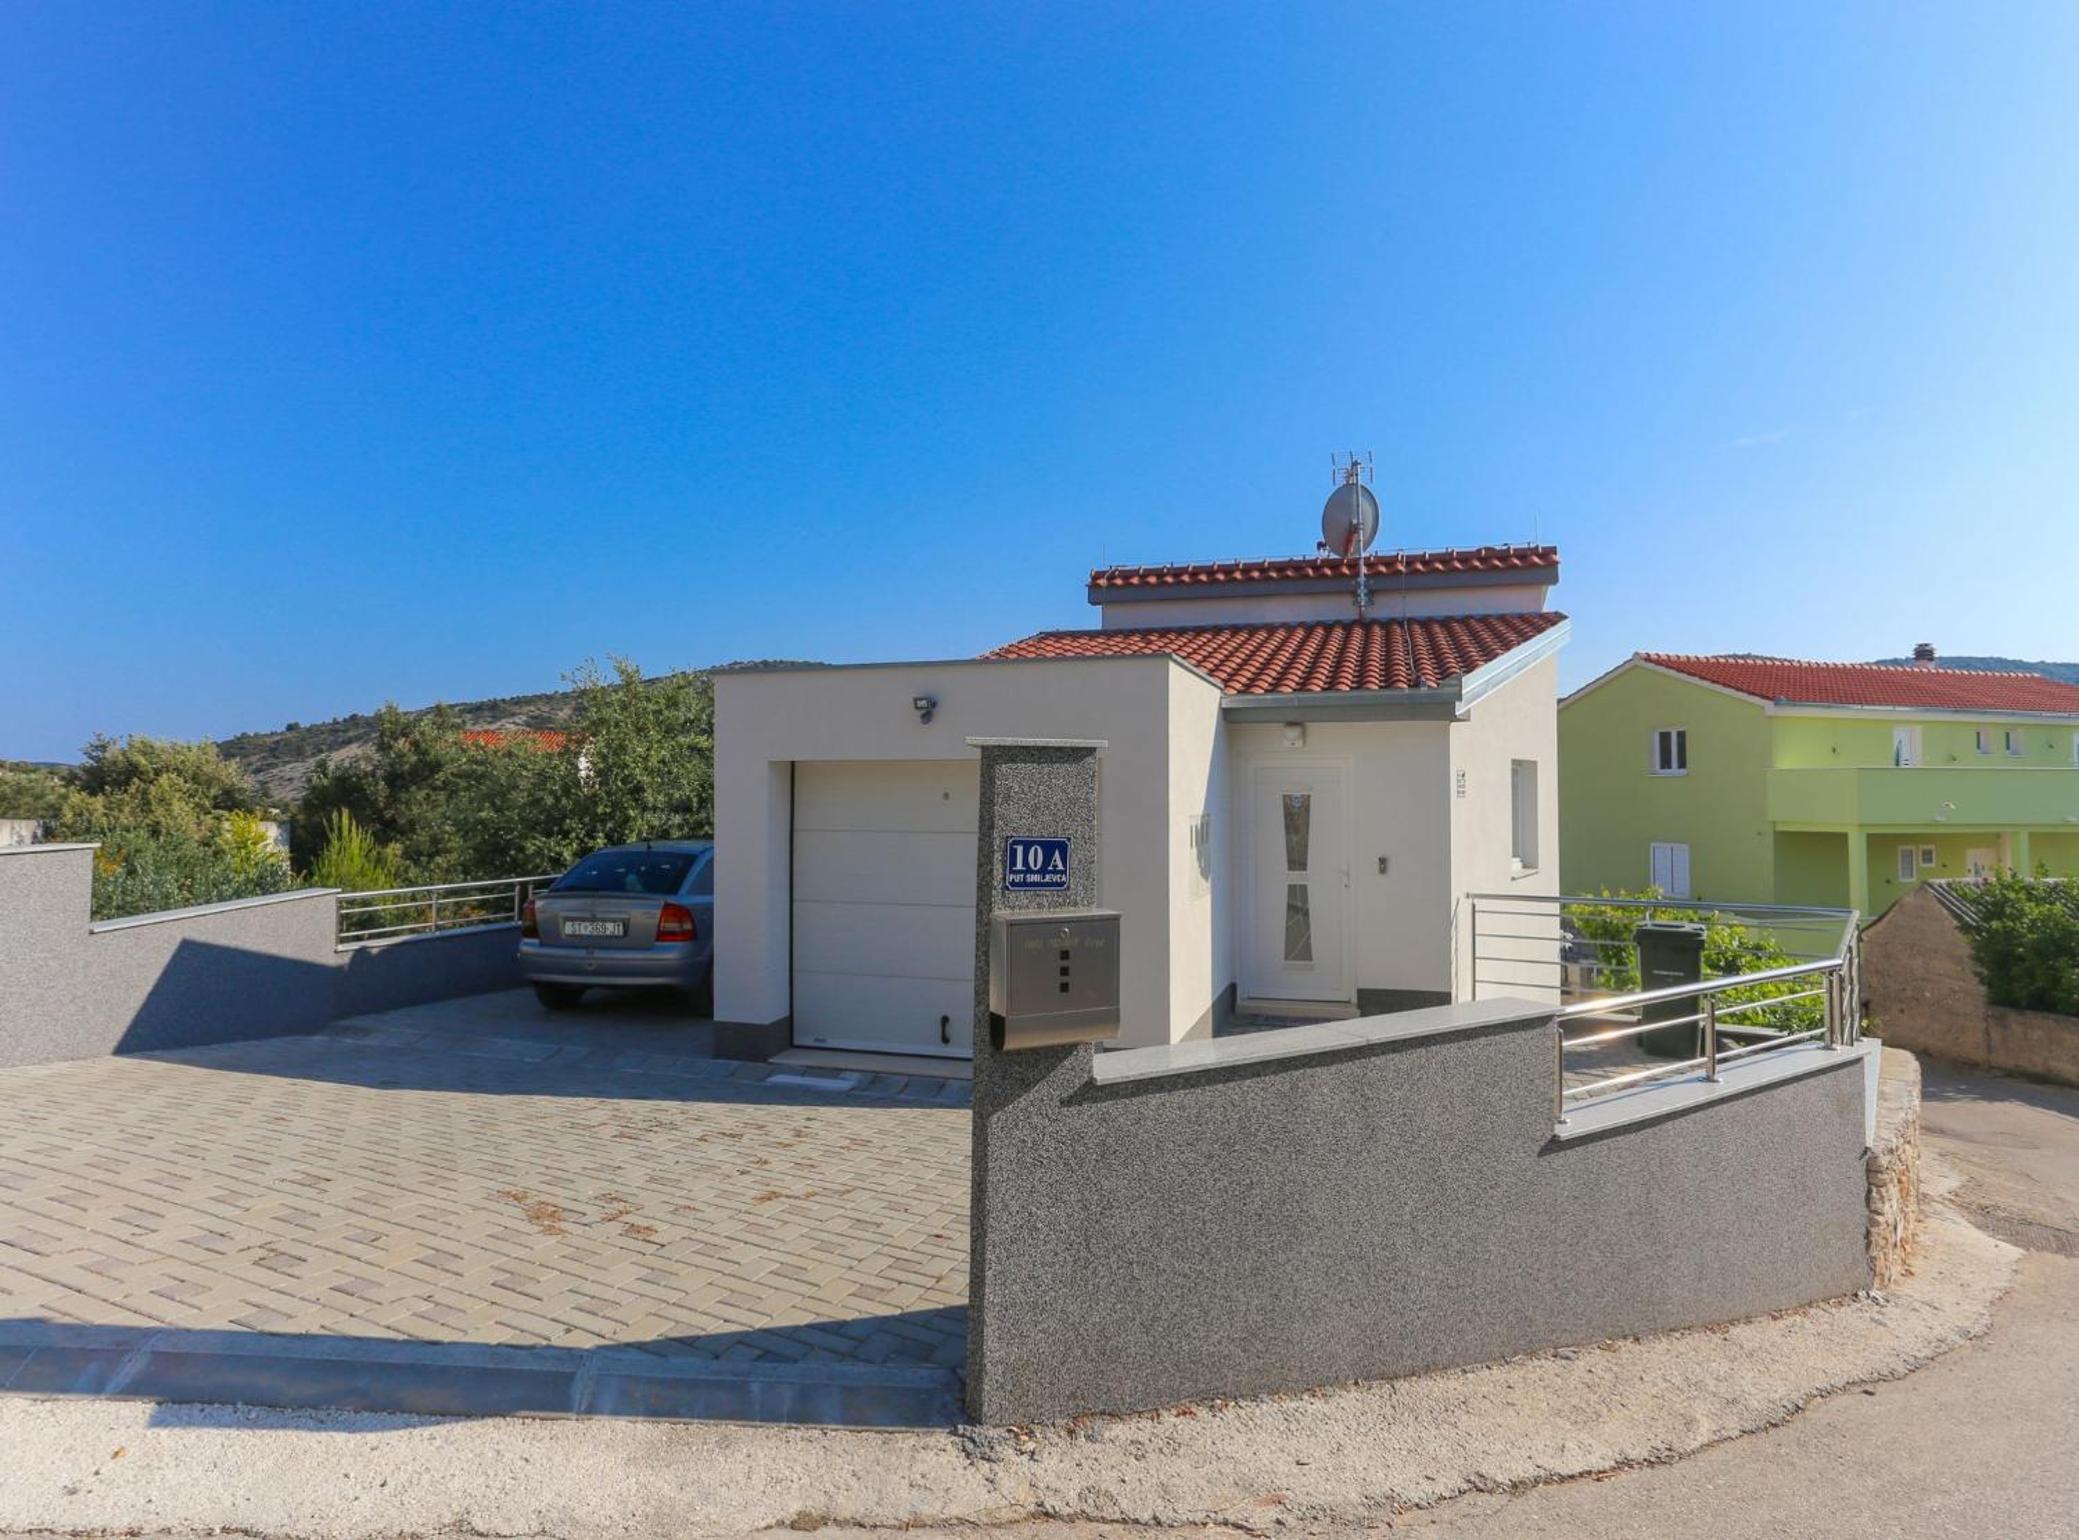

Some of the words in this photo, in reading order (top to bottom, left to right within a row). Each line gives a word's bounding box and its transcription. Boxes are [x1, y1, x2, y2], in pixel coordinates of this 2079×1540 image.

[1009, 873, 1024, 883] PUT
[1025, 873, 1067, 883] SMILJEVCA
[571, 921, 583, 935] ST
